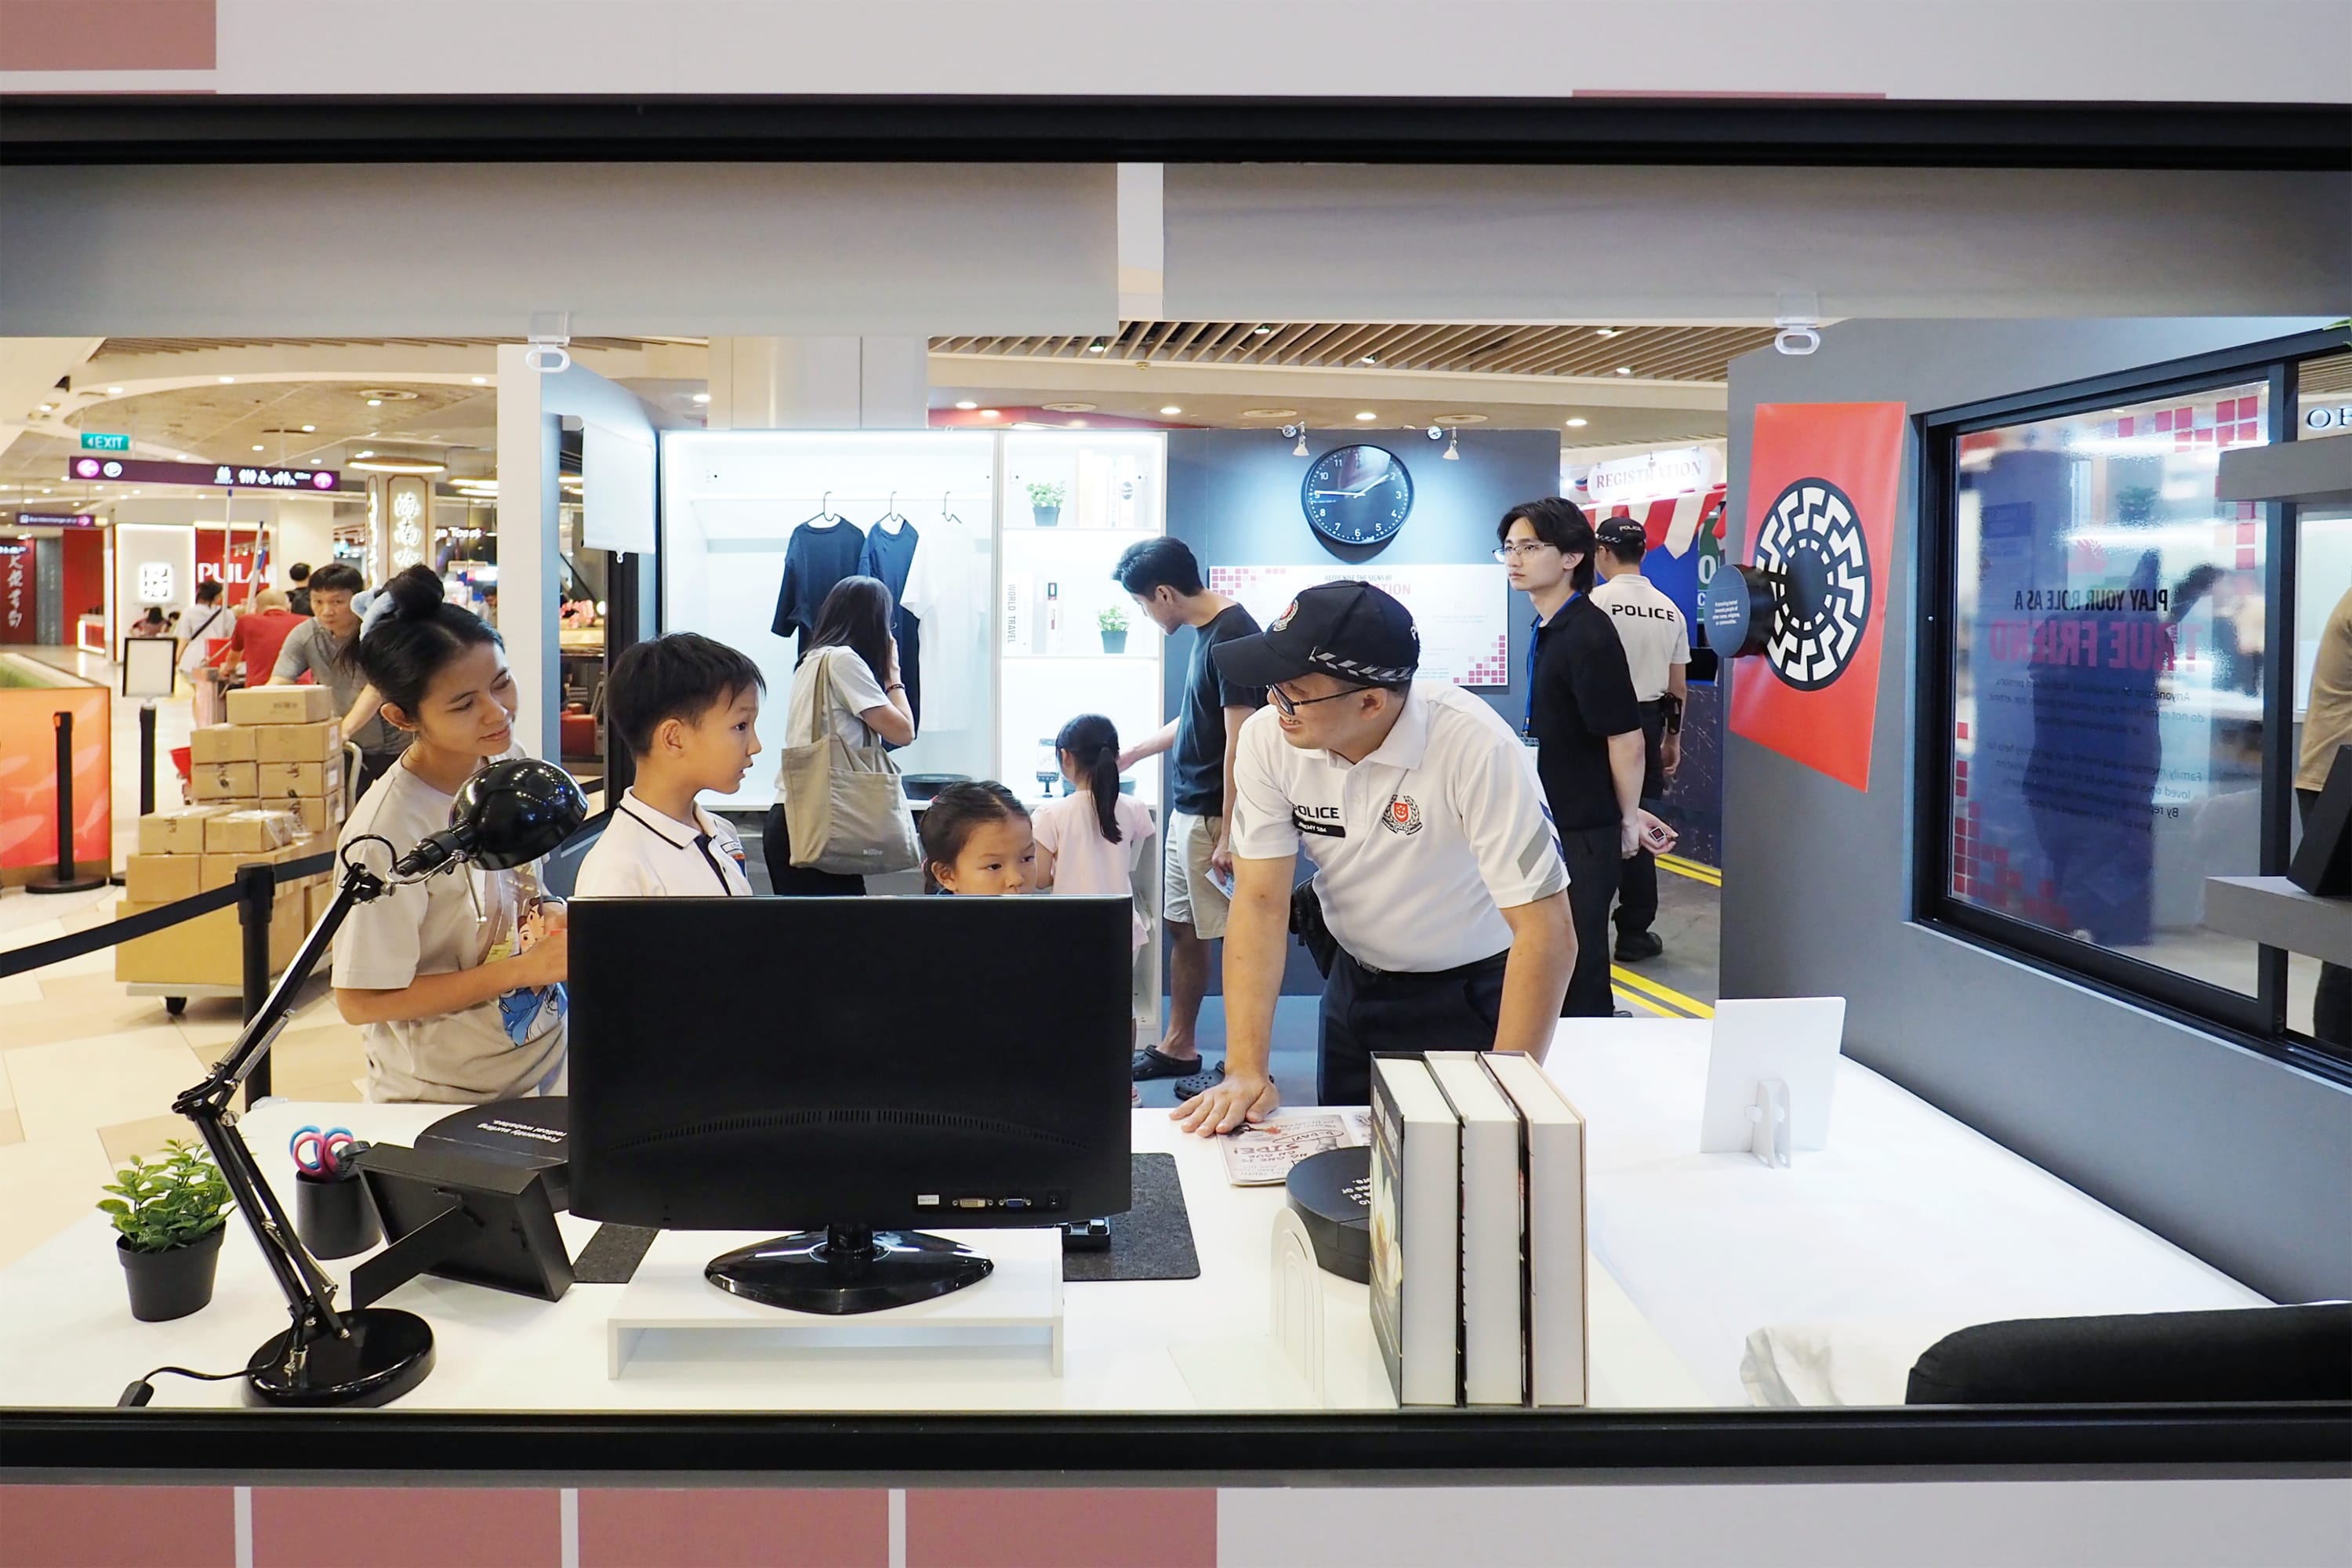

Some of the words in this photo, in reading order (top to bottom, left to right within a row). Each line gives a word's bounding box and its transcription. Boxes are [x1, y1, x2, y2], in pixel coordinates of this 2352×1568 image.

[95, 435, 123, 449] EXIT
[1320, 471, 1329, 480] 10
[1390, 472, 1396, 481] 2
[1596, 460, 1701, 488] REGISTRATION
[1396, 491, 1402, 499] 3
[1320, 508, 1326, 517] 8
[448, 527, 482, 540] Toast
[1355, 528, 1361, 537] 6
[1375, 523, 1381, 532] 5
[1007, 583, 1016, 611] WORLD
[1612, 604, 1675, 622] POLICE
[1007, 615, 1016, 644] TRAVEL
[1293, 804, 1340, 819] POLICE
[1234, 1143, 1300, 1154] SIDE!
